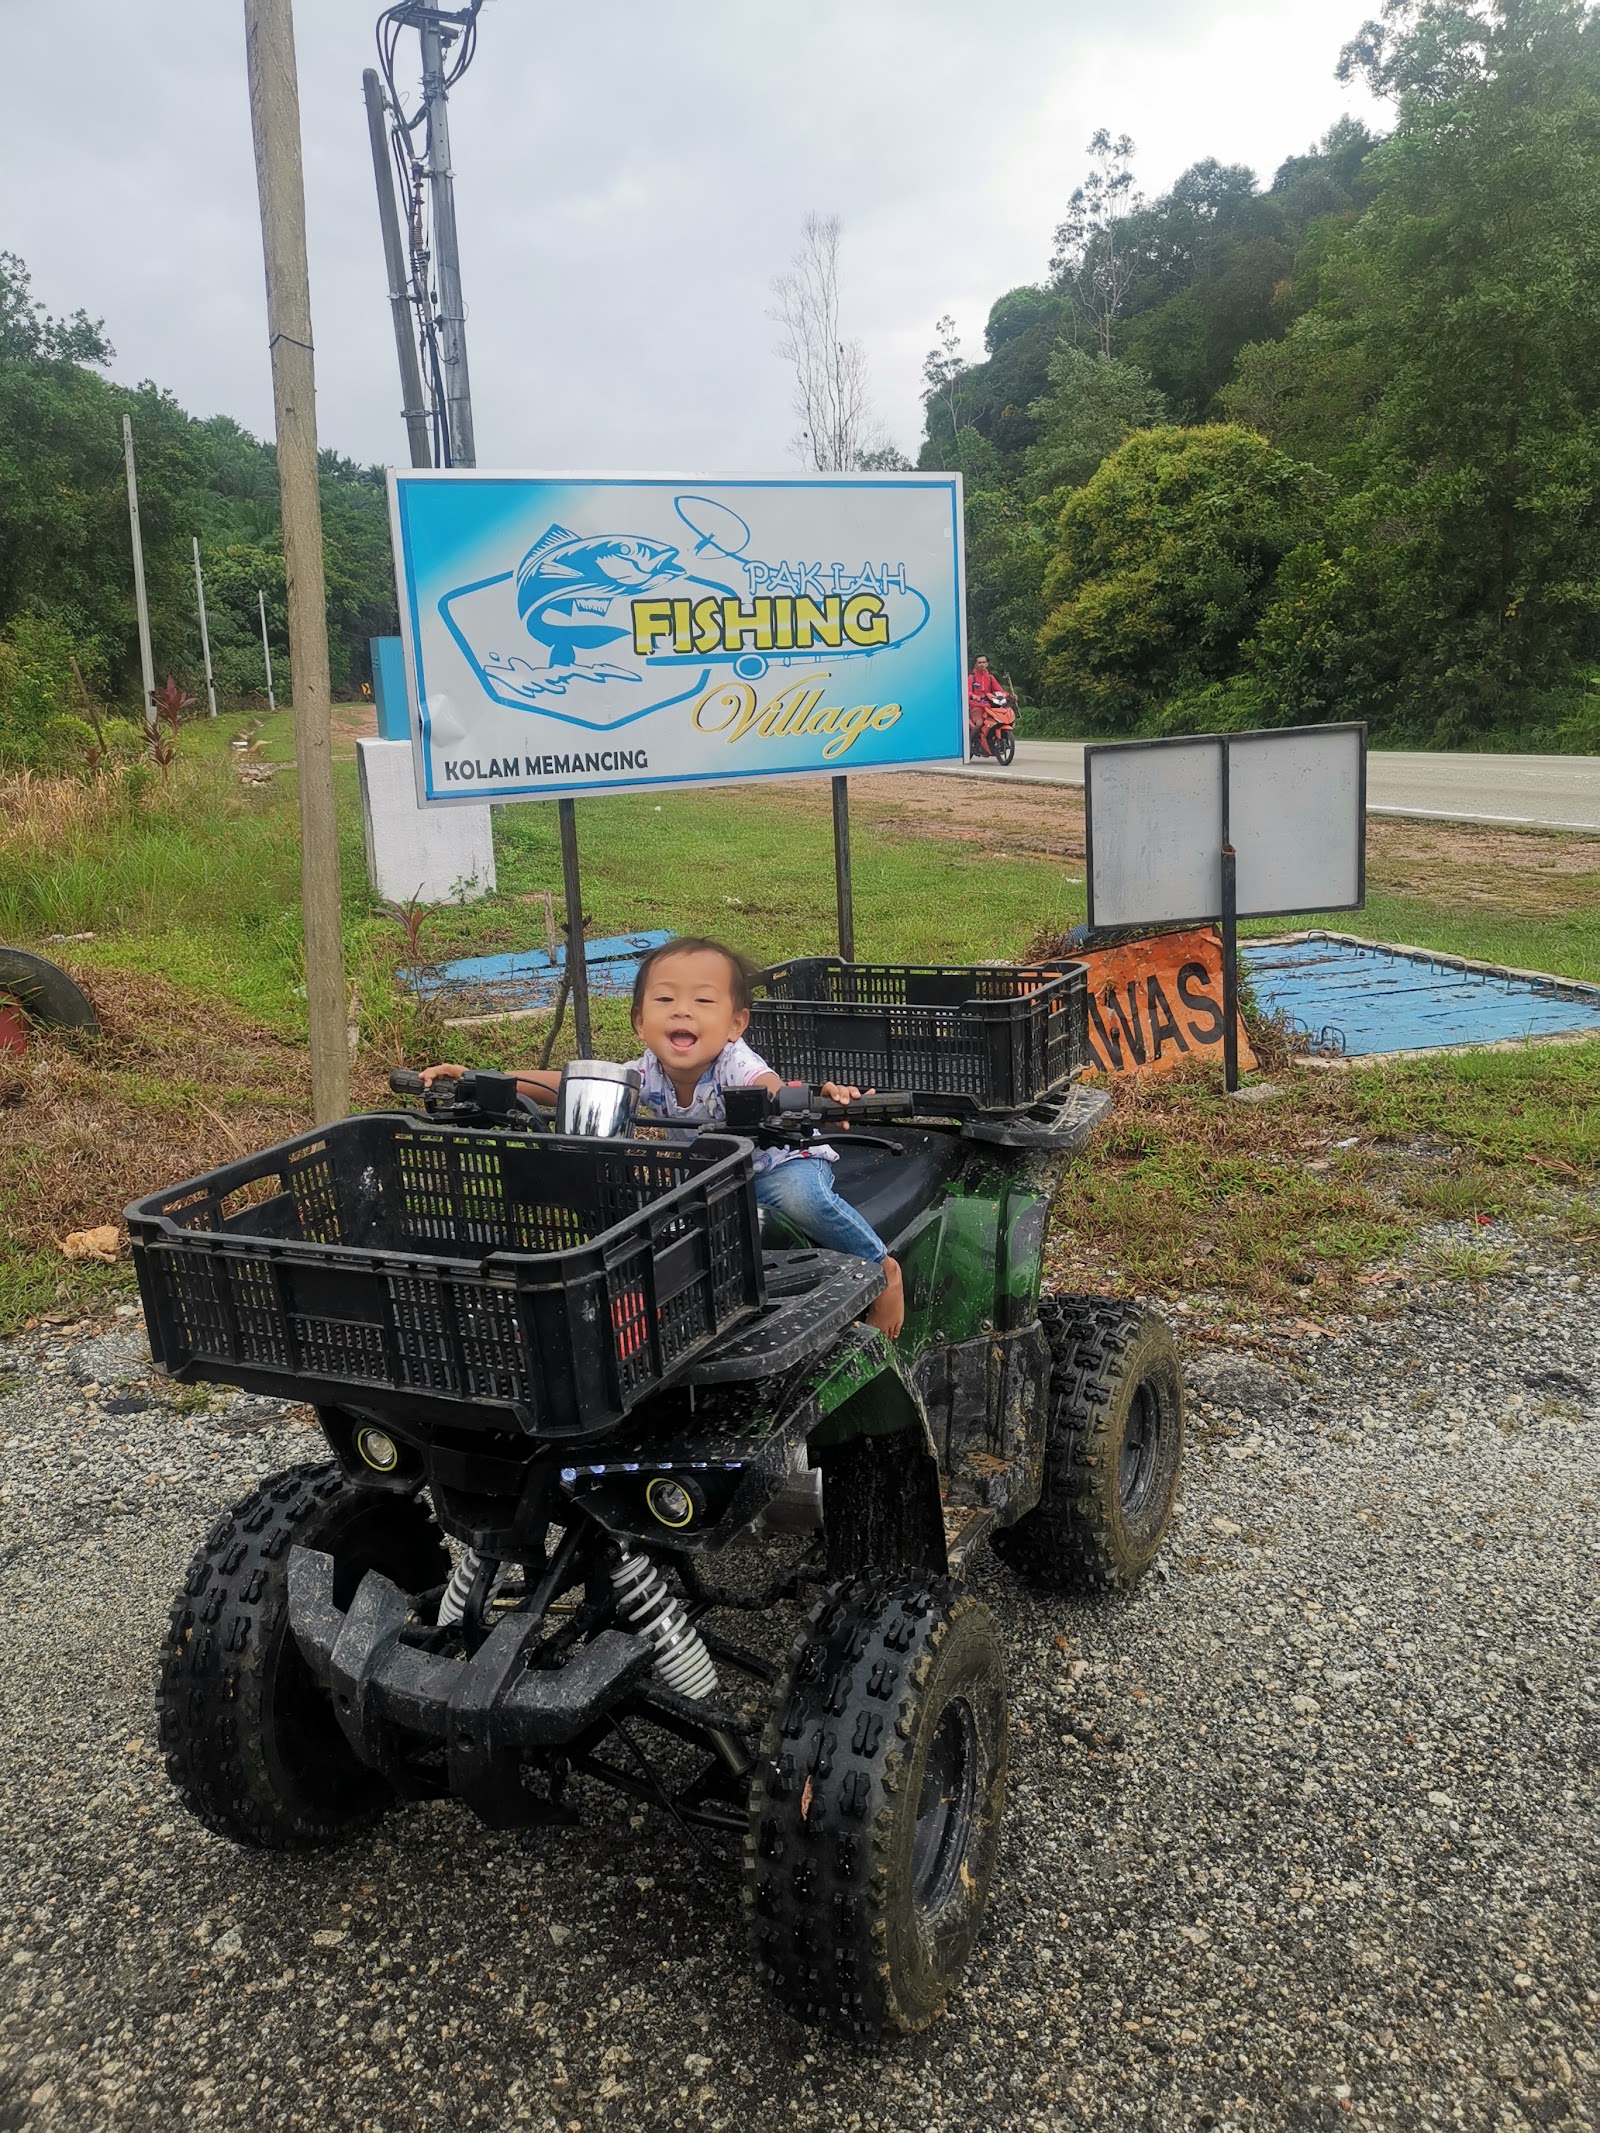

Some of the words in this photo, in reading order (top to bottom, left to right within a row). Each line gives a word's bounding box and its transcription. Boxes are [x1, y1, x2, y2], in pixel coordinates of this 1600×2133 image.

[742, 560, 827, 597] PAK
[830, 560, 907, 596] LAH
[631, 593, 890, 656] FISHING
[691, 672, 904, 760] Village
[444, 757, 520, 781] KOLAM
[525, 749, 648, 776] MEMANCING
